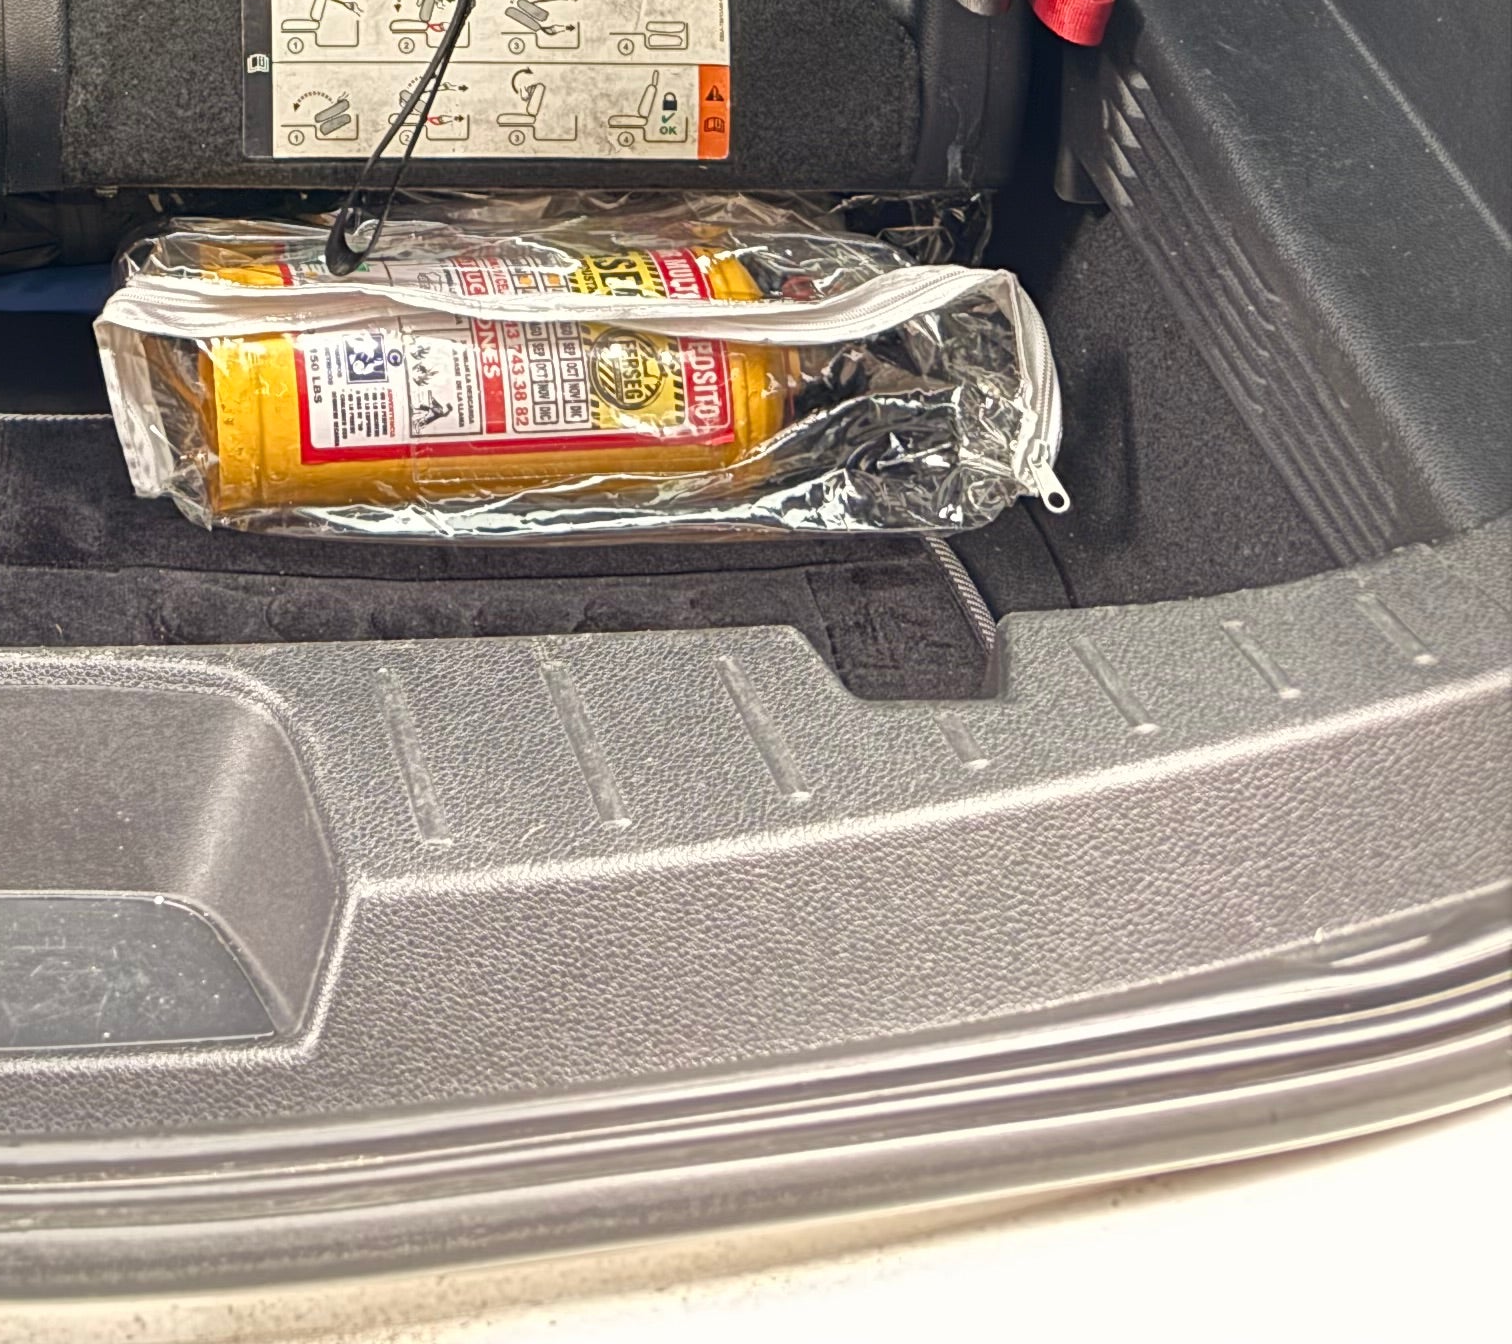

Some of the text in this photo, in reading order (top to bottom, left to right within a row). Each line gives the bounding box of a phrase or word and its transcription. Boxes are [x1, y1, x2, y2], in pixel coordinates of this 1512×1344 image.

[659, 125, 678, 135] OK
[533, 342, 546, 357] SEP
[563, 342, 576, 356] SEP
[509, 343, 525, 376] 743
[535, 363, 549, 379] OCT
[566, 362, 579, 378] OCT
[312, 376, 323, 404] LBS
[513, 380, 528, 401] 38
[537, 383, 550, 400] NOV
[569, 383, 581, 400] NOV
[516, 406, 529, 426] 82
[539, 406, 552, 421] DIC
[570, 405, 583, 419] DIC
